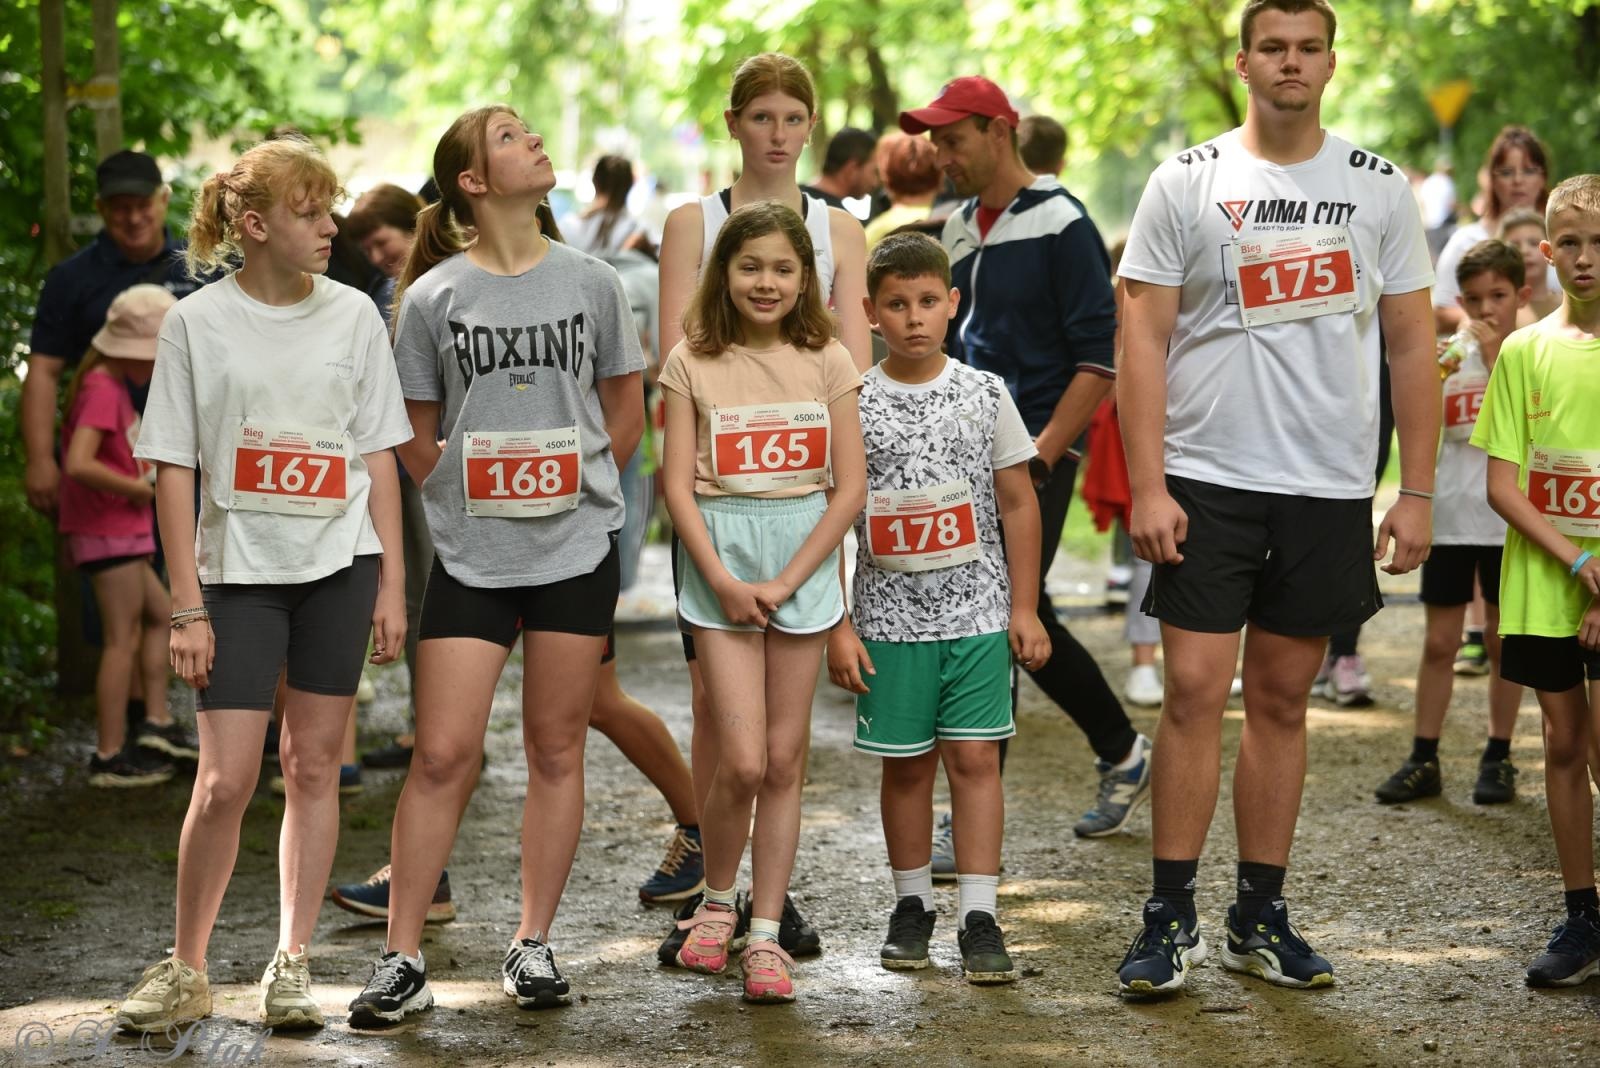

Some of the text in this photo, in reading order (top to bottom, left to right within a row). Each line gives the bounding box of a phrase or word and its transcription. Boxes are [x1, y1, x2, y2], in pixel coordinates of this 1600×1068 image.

[1349, 149, 1394, 175] 013
[1254, 199, 1356, 226] MMA CITY
[1240, 243, 1262, 254] Bieg
[1316, 237, 1338, 248] 4500
[1337, 236, 1346, 245] M
[1259, 256, 1337, 302] 175
[448, 312, 585, 393] BOXING
[509, 371, 537, 387] EVERLAST
[720, 413, 740, 423] Bieg
[793, 413, 816, 423] 4500
[816, 413, 825, 421] M
[243, 427, 264, 440] Bieg
[315, 440, 335, 450] 4500
[335, 443, 344, 451] M
[472, 437, 492, 448] Bieg
[545, 440, 567, 450] 4500
[567, 439, 576, 447] M
[735, 431, 810, 471] 165
[1534, 450, 1549, 463] Bieg
[255, 454, 331, 494] 167
[487, 459, 563, 497] 168
[874, 495, 891, 506] Bieg
[941, 491, 960, 504] 4500
[960, 489, 968, 498] M
[887, 511, 961, 552] 178
